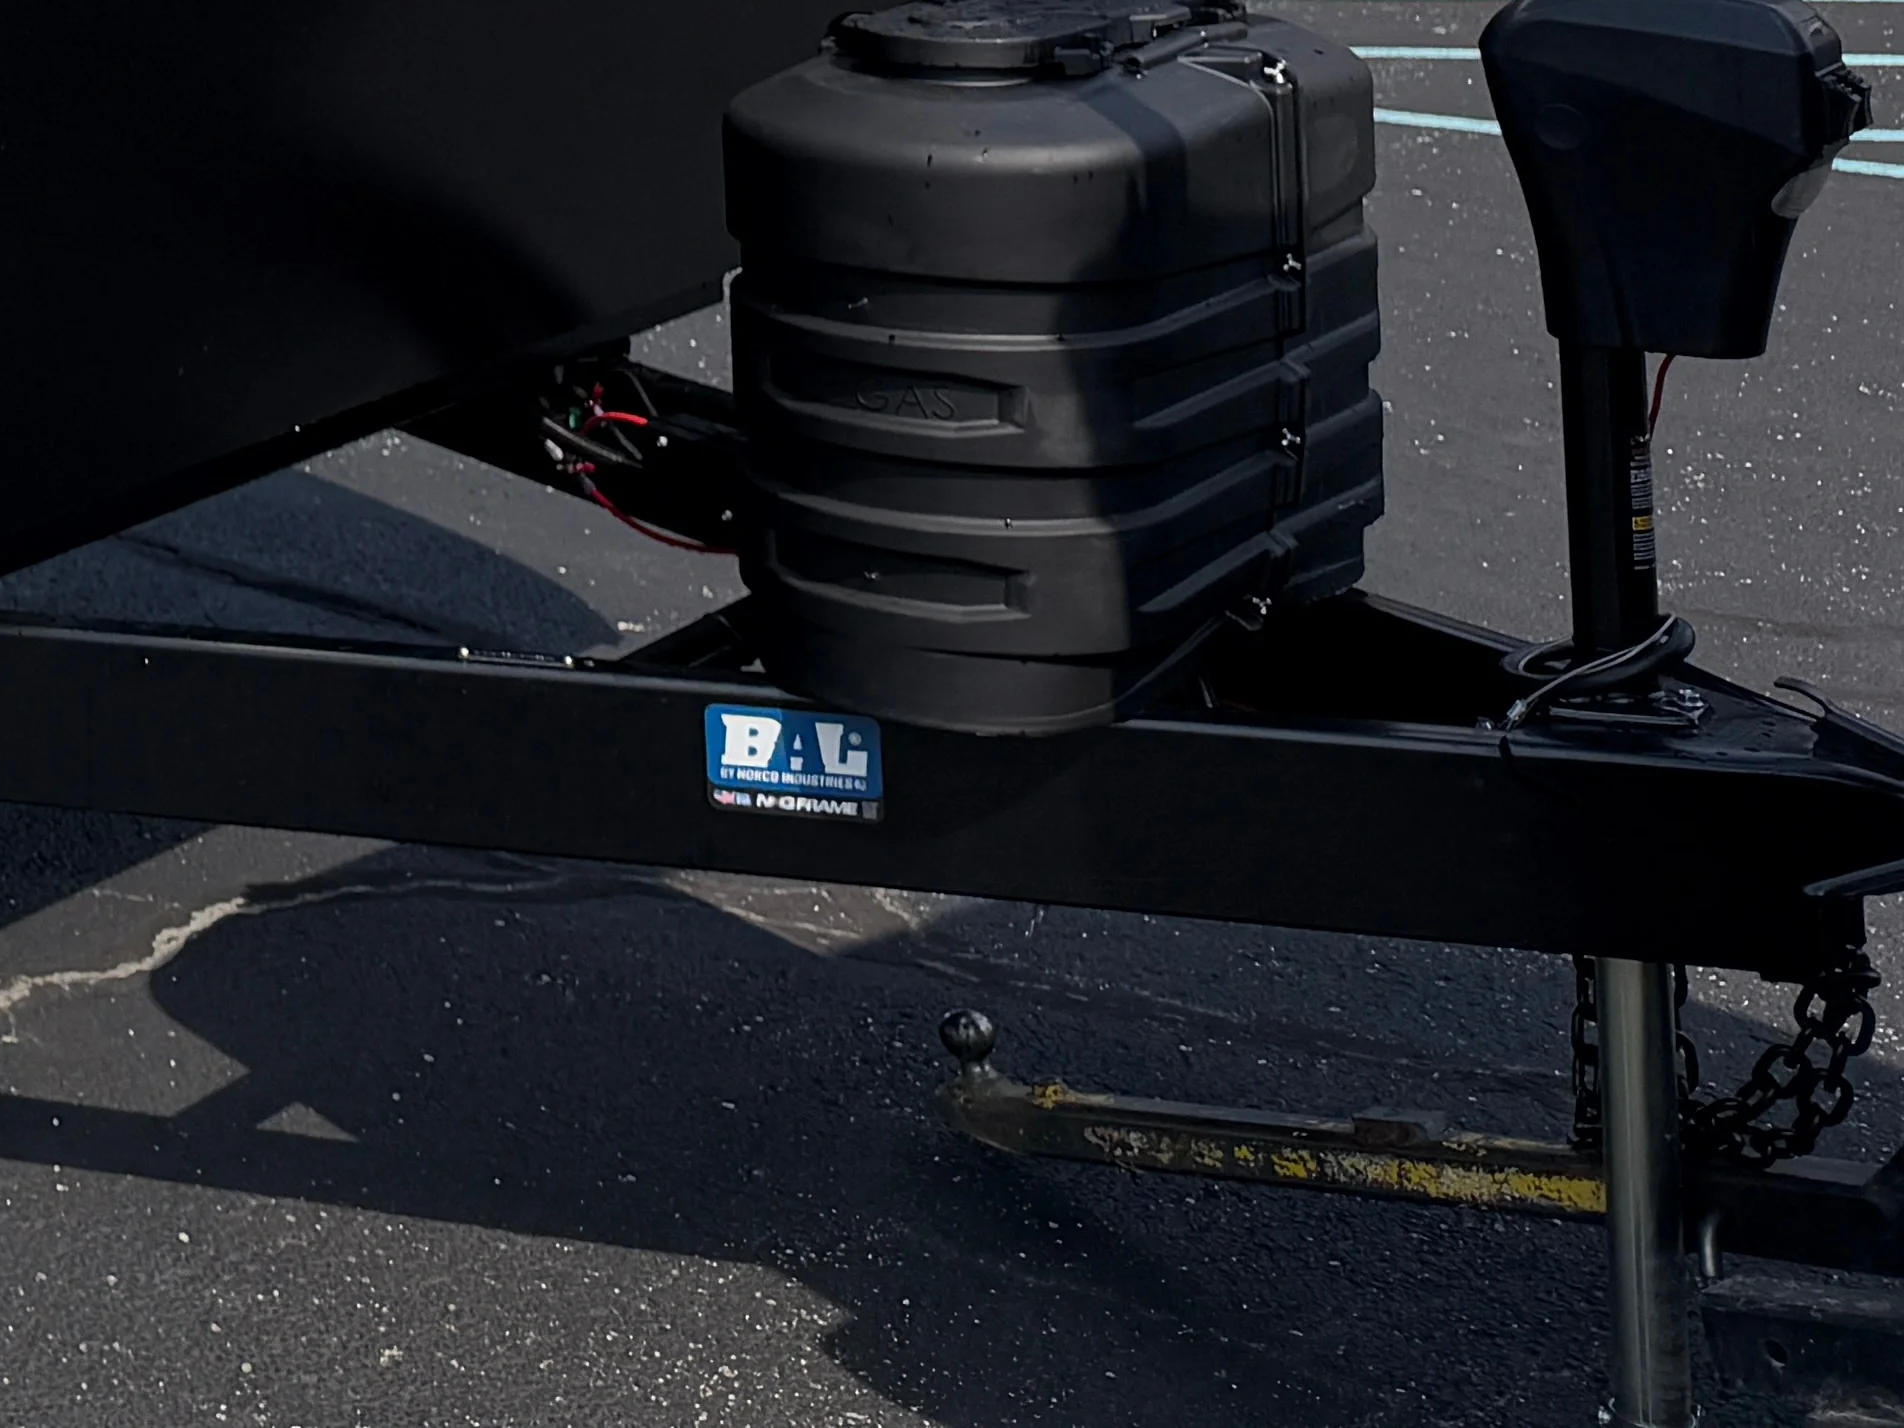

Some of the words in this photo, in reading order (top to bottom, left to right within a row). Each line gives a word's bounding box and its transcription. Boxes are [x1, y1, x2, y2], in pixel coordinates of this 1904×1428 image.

[854, 376, 958, 422] GAS
[736, 768, 780, 783] NORCO
[781, 771, 853, 790] INDUSTRIES
